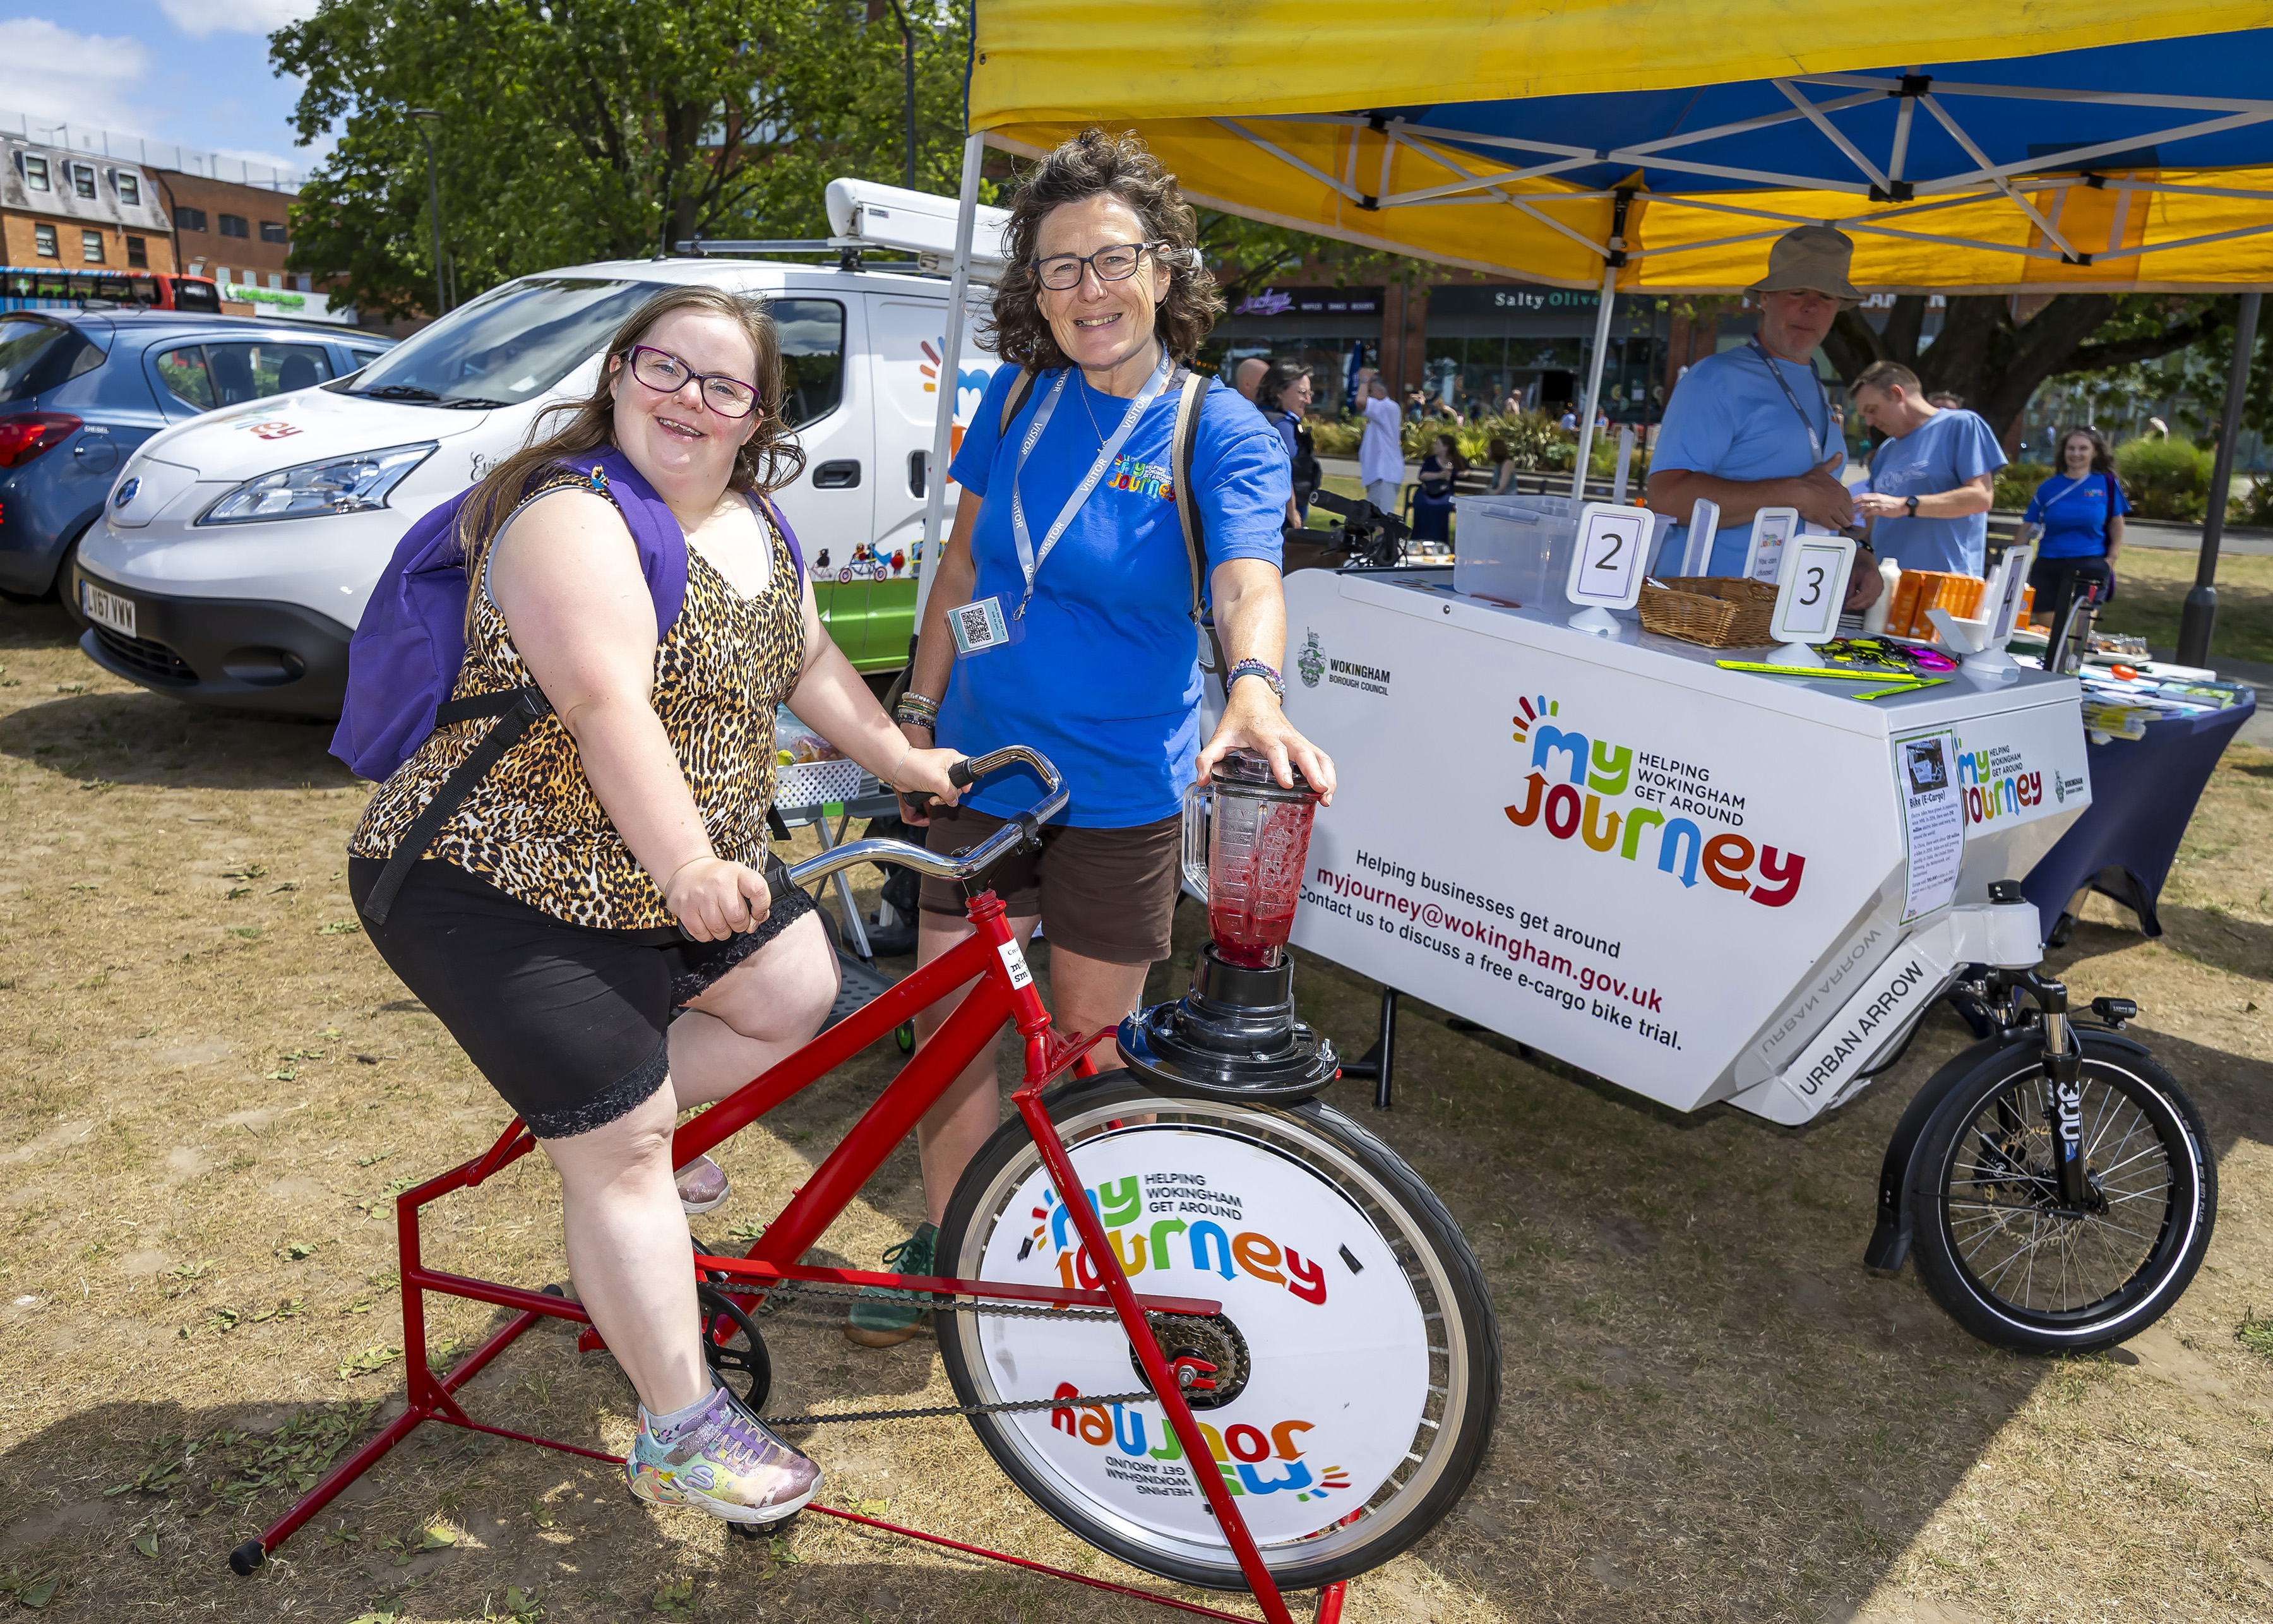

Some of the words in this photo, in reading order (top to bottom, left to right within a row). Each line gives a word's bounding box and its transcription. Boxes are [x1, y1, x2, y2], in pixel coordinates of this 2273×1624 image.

[1495, 292, 1544, 309] Salty
[1122, 395, 1149, 429] VISITOR
[1021, 422, 1042, 455] VISITOR
[1080, 457, 1108, 493] VISITOR
[1012, 491, 1023, 529] VISITOR
[1039, 522, 1065, 556] VISITOR
[1595, 534, 1623, 571] 2
[1799, 567, 1824, 606] 3
[2003, 576, 2015, 612] 4
[1329, 674, 1359, 689] BOROUGH
[1361, 682, 1388, 696] COUNCIL
[1330, 659, 1390, 683] WOKINGHAM
[1532, 725, 1633, 795] my
[1639, 751, 1710, 782] HELPING
[1957, 750, 1990, 784] my
[1989, 745, 2010, 756] HELPING
[1991, 753, 2021, 767] WOKINGHAM
[1992, 768, 2002, 777] GET
[2003, 763, 2023, 774] AROUND
[1635, 785, 1666, 803] GET
[1670, 797, 1743, 826] AROUND
[1638, 768, 1746, 810] WOKINGHAM
[1909, 797, 1921, 809] Bike
[1922, 789, 1945, 806] (E-Cargo)
[1356, 850, 1416, 887] Helping
[1421, 871, 1515, 919] businesses
[1520, 912, 1549, 932] get
[1554, 924, 1621, 958] around
[1316, 868, 1662, 1013] myjourney@wokingham.gov.uk
[1299, 884, 1352, 918] Contact
[1357, 909, 1374, 926] us
[1380, 916, 1394, 933] to
[1399, 924, 1460, 959] discuss
[1465, 952, 1474, 966] a
[1481, 955, 1513, 980] free
[1518, 973, 1585, 1010] e-cargo
[1592, 999, 1632, 1029] bike
[1638, 1018, 1681, 1051] trial.
[1799, 1030, 1862, 1096] URBAN
[1858, 960, 1923, 1036] ARROW
[1144, 1173, 1207, 1186] HELPING
[1146, 1187, 1243, 1208] WOKINGHAM
[1149, 1202, 1174, 1212] GET
[1179, 1202, 1243, 1221] AROUND
[1105, 1455, 1158, 1473] AROUND
[1105, 1467, 1191, 1486] WOKINGHAM
[1162, 1466, 1186, 1476] GET
[1136, 1485, 1195, 1496] HELPING
